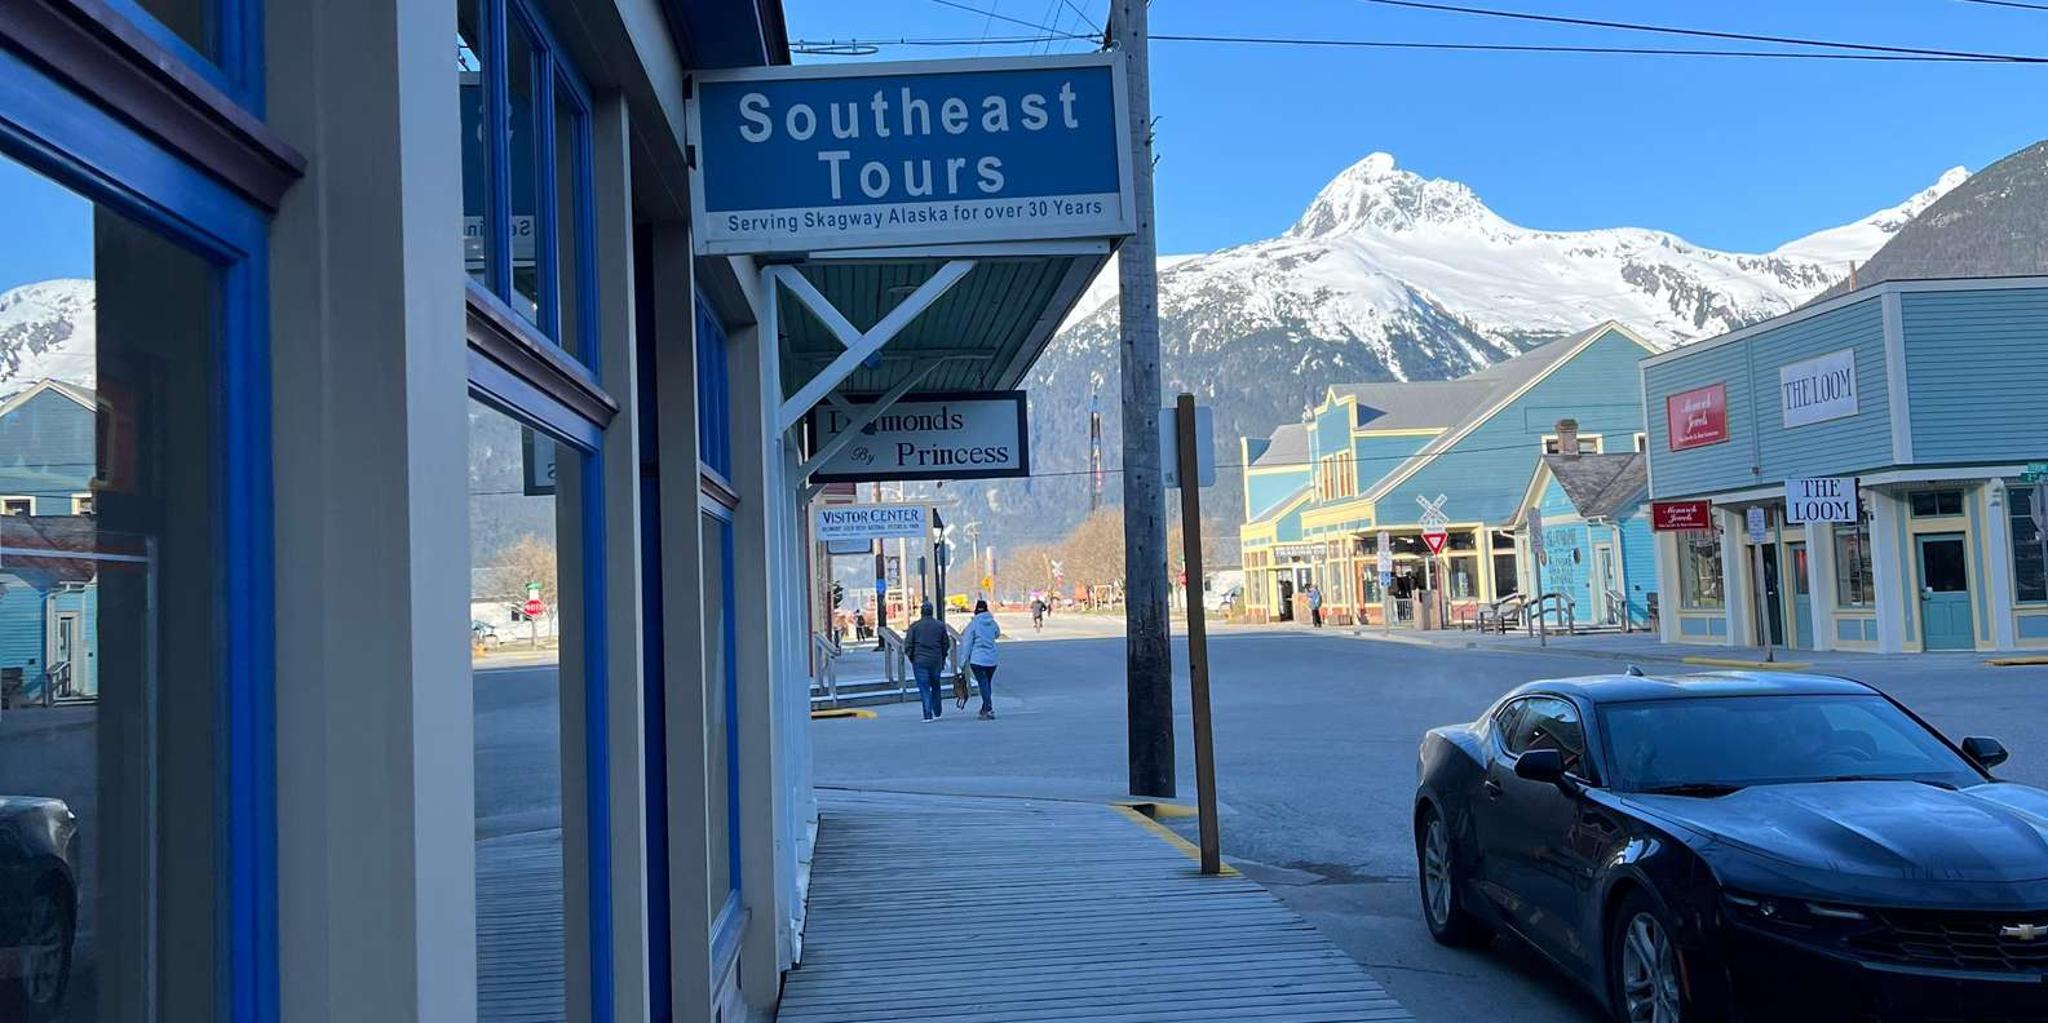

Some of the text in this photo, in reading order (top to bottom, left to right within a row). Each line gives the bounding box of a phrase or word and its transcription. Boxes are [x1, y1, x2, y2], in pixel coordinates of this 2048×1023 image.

[739, 80, 1079, 143] Southeast
[817, 149, 1006, 200] Tours
[728, 199, 1103, 233] Serving Skagway Alaska for over 30 Years
[1784, 367, 1852, 410] THE LOOM
[828, 406, 964, 434] Dmonds
[850, 442, 1009, 466] By Princess
[1801, 478, 1841, 498] THE
[822, 508, 919, 524] VISITOR CENTER
[1794, 501, 1851, 521] LOOM
